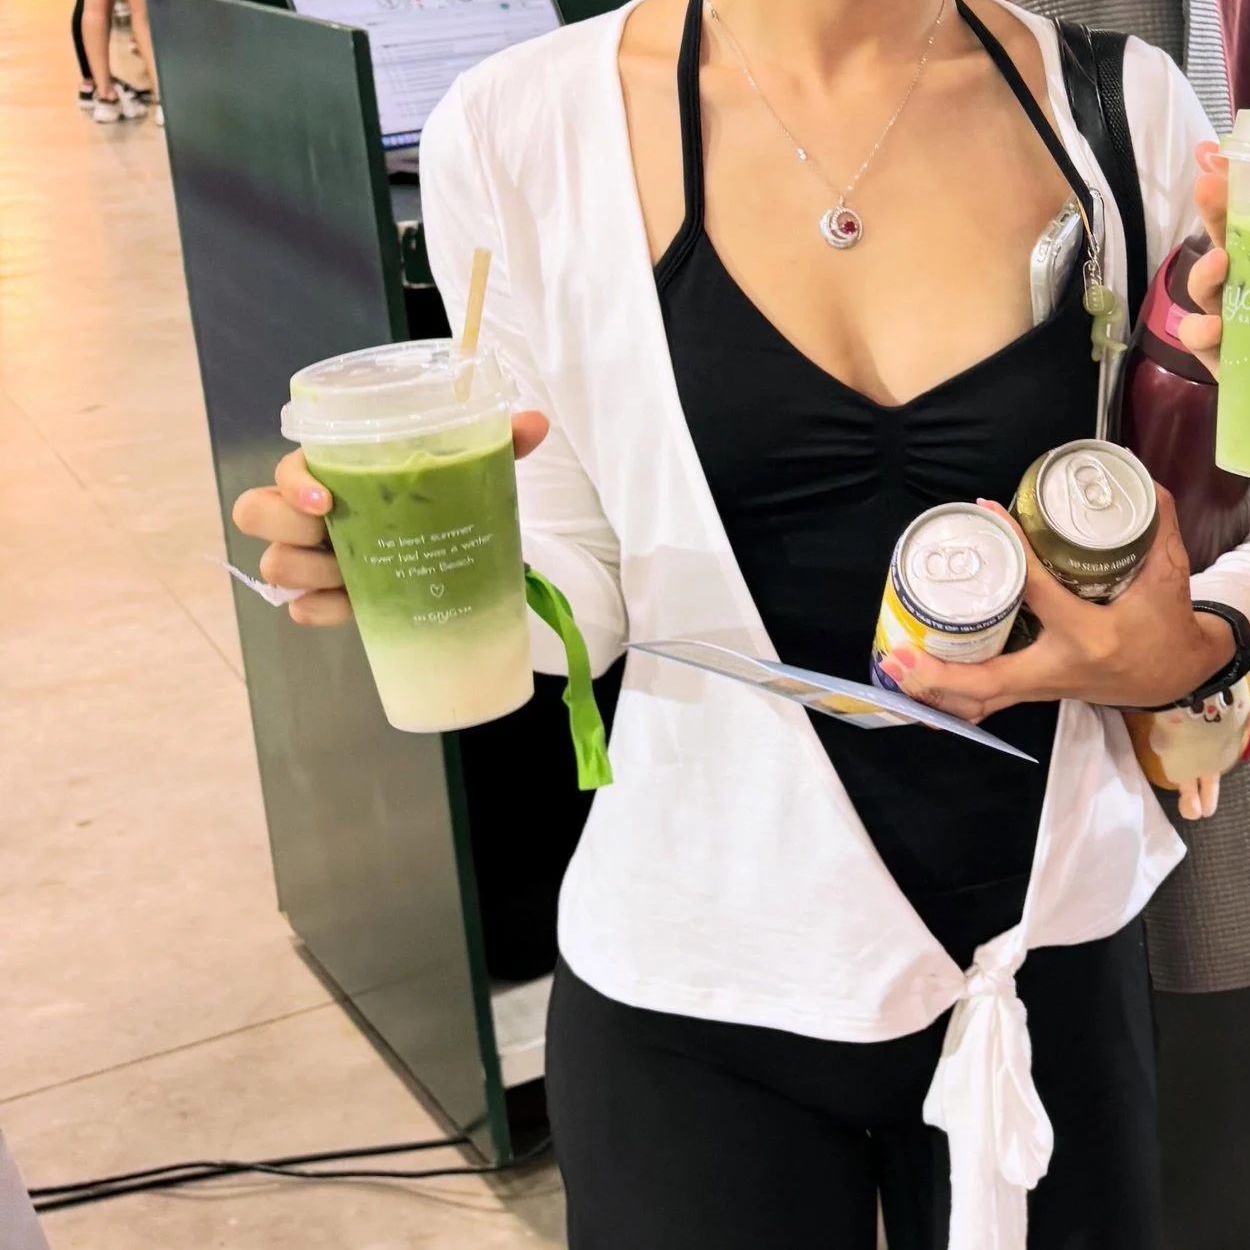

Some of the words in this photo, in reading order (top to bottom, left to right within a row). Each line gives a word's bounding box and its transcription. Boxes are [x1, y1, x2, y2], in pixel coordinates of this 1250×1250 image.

[1068, 557, 1081, 568] NO
[1081, 562, 1110, 573] SUGAR
[1111, 552, 1137, 571] ADDED
